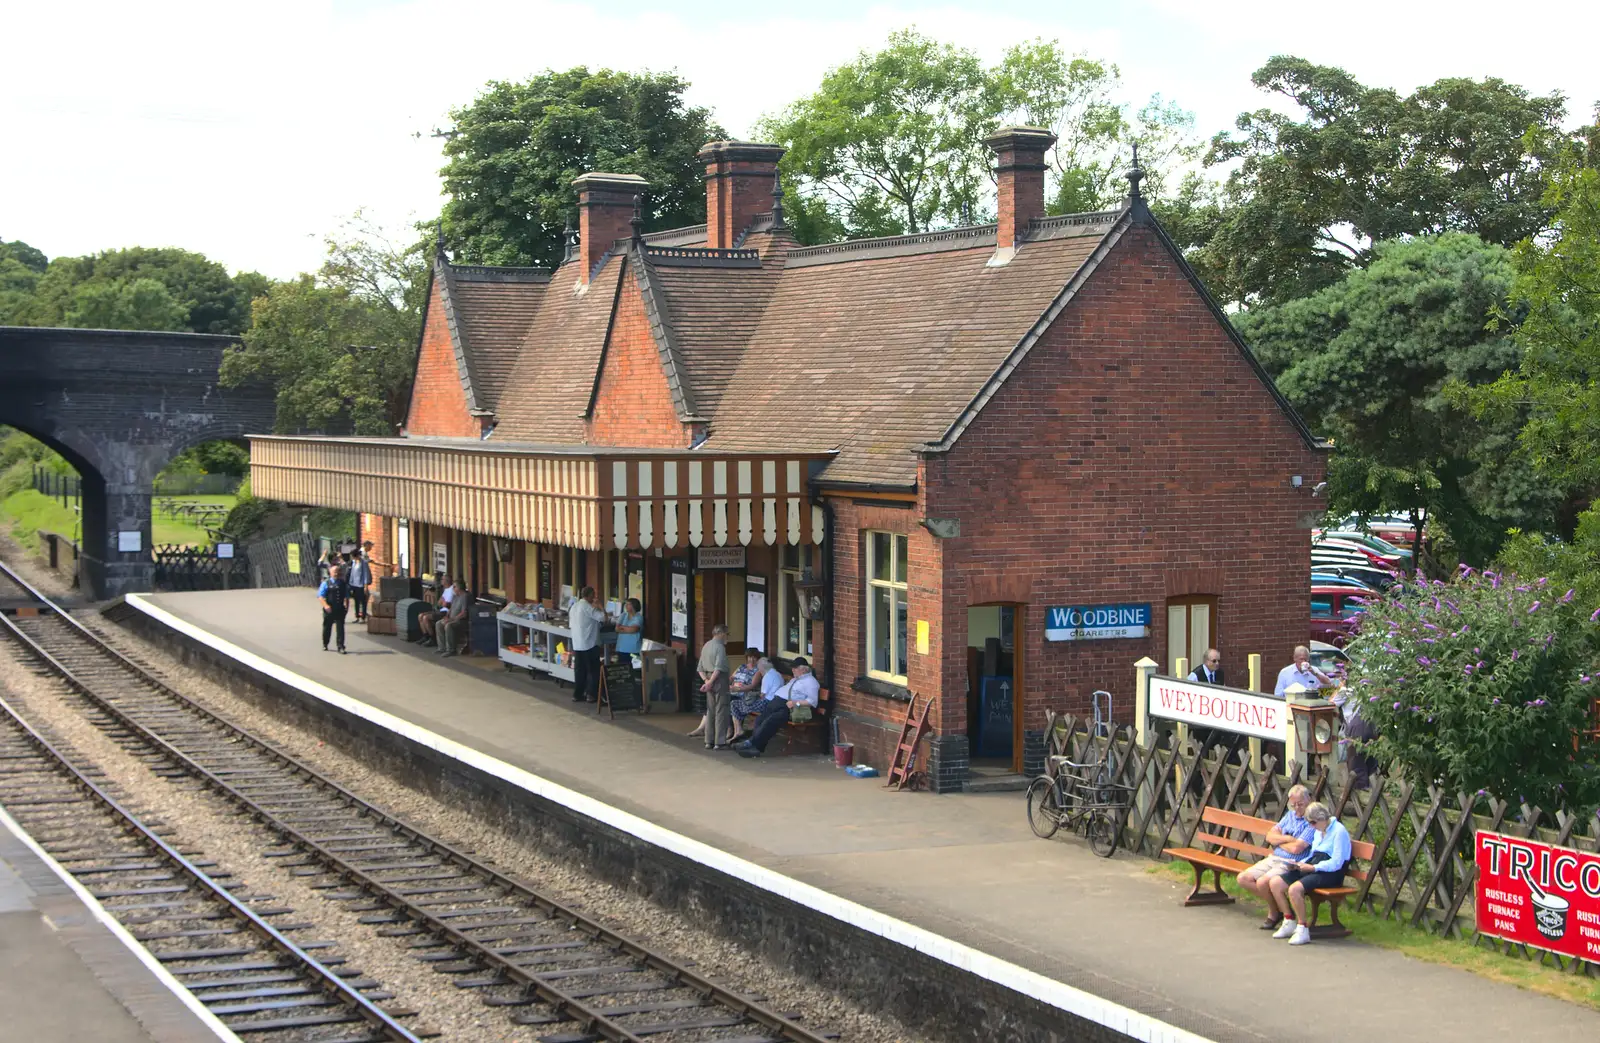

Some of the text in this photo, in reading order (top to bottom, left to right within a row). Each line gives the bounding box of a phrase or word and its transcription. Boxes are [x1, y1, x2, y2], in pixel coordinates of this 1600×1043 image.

[1053, 608, 1145, 627] WOODBINE
[989, 711, 1012, 723] PAIN
[1160, 688, 1277, 729] WEYBOURNE
[1483, 838, 1600, 900] TRICO
[1485, 888, 1524, 905] RUSTLESS
[1488, 903, 1520, 919] FURNACE
[1537, 924, 1564, 937] RUSTLESS
